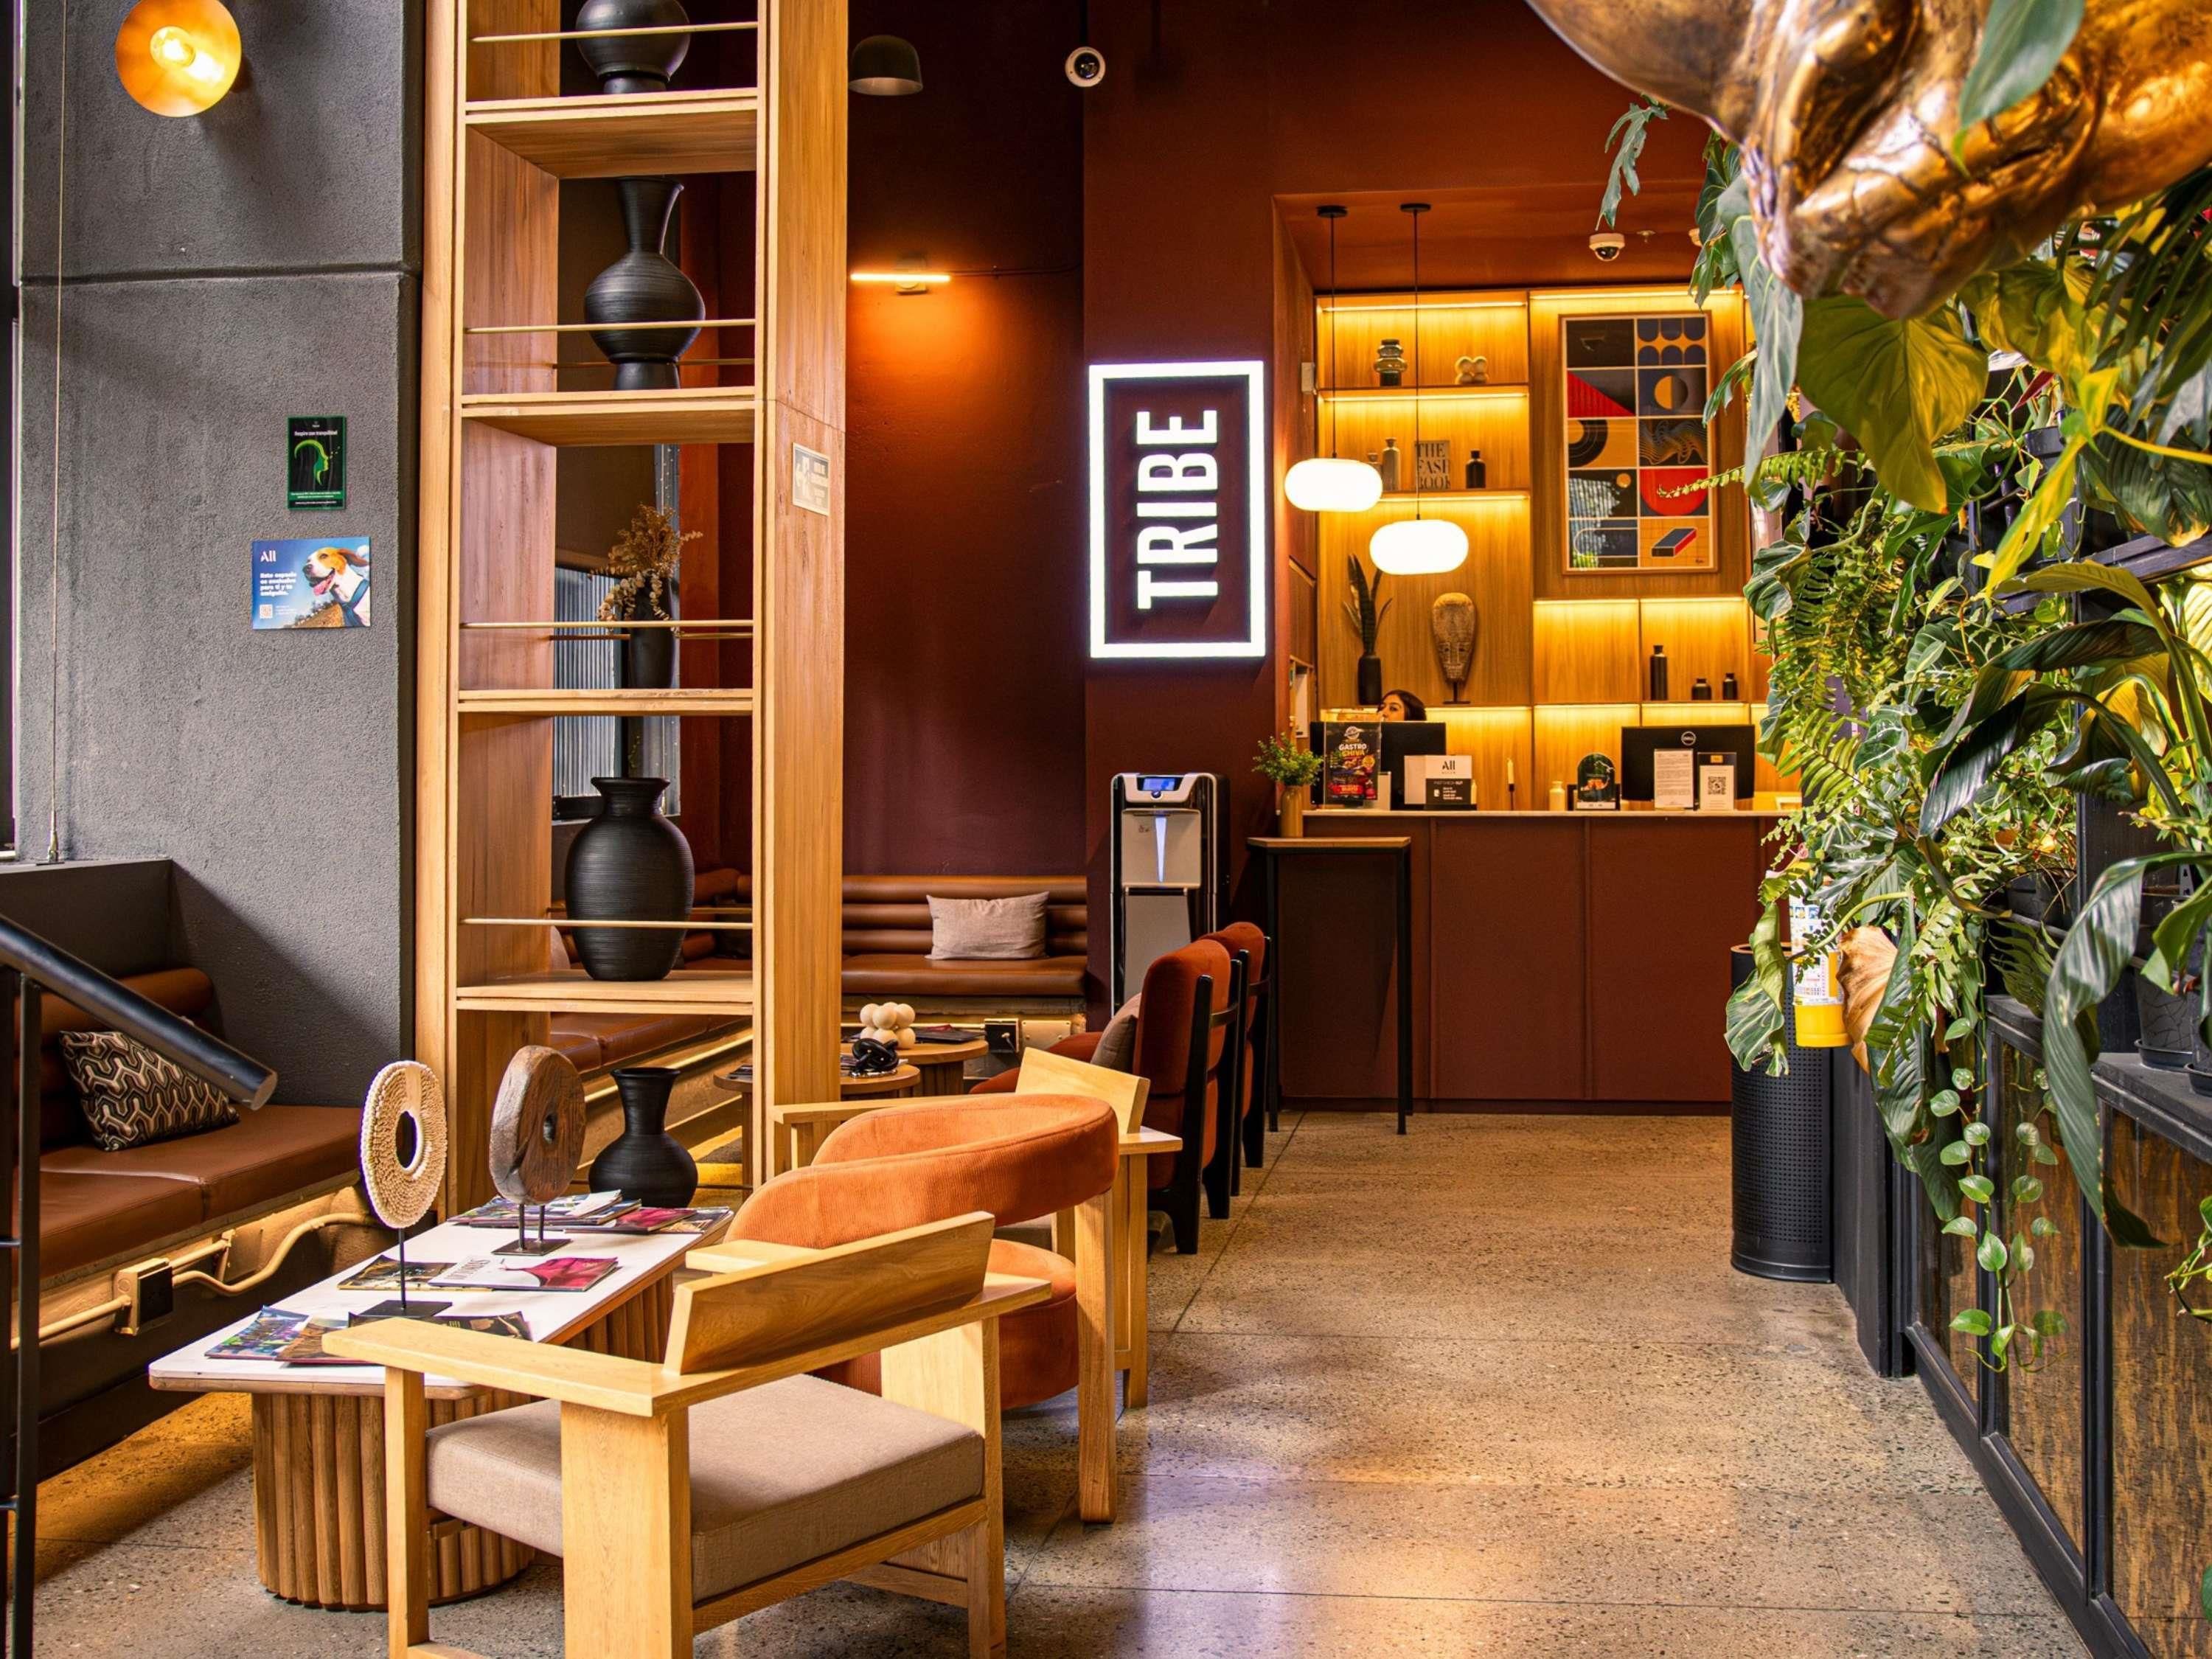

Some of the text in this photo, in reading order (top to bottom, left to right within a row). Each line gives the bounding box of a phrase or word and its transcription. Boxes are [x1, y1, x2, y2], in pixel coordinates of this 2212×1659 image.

[1414, 442, 1445, 457] THE
[1136, 410, 1218, 610] TRIBE
[260, 550, 276, 563] All
[1442, 760, 1455, 771] All
